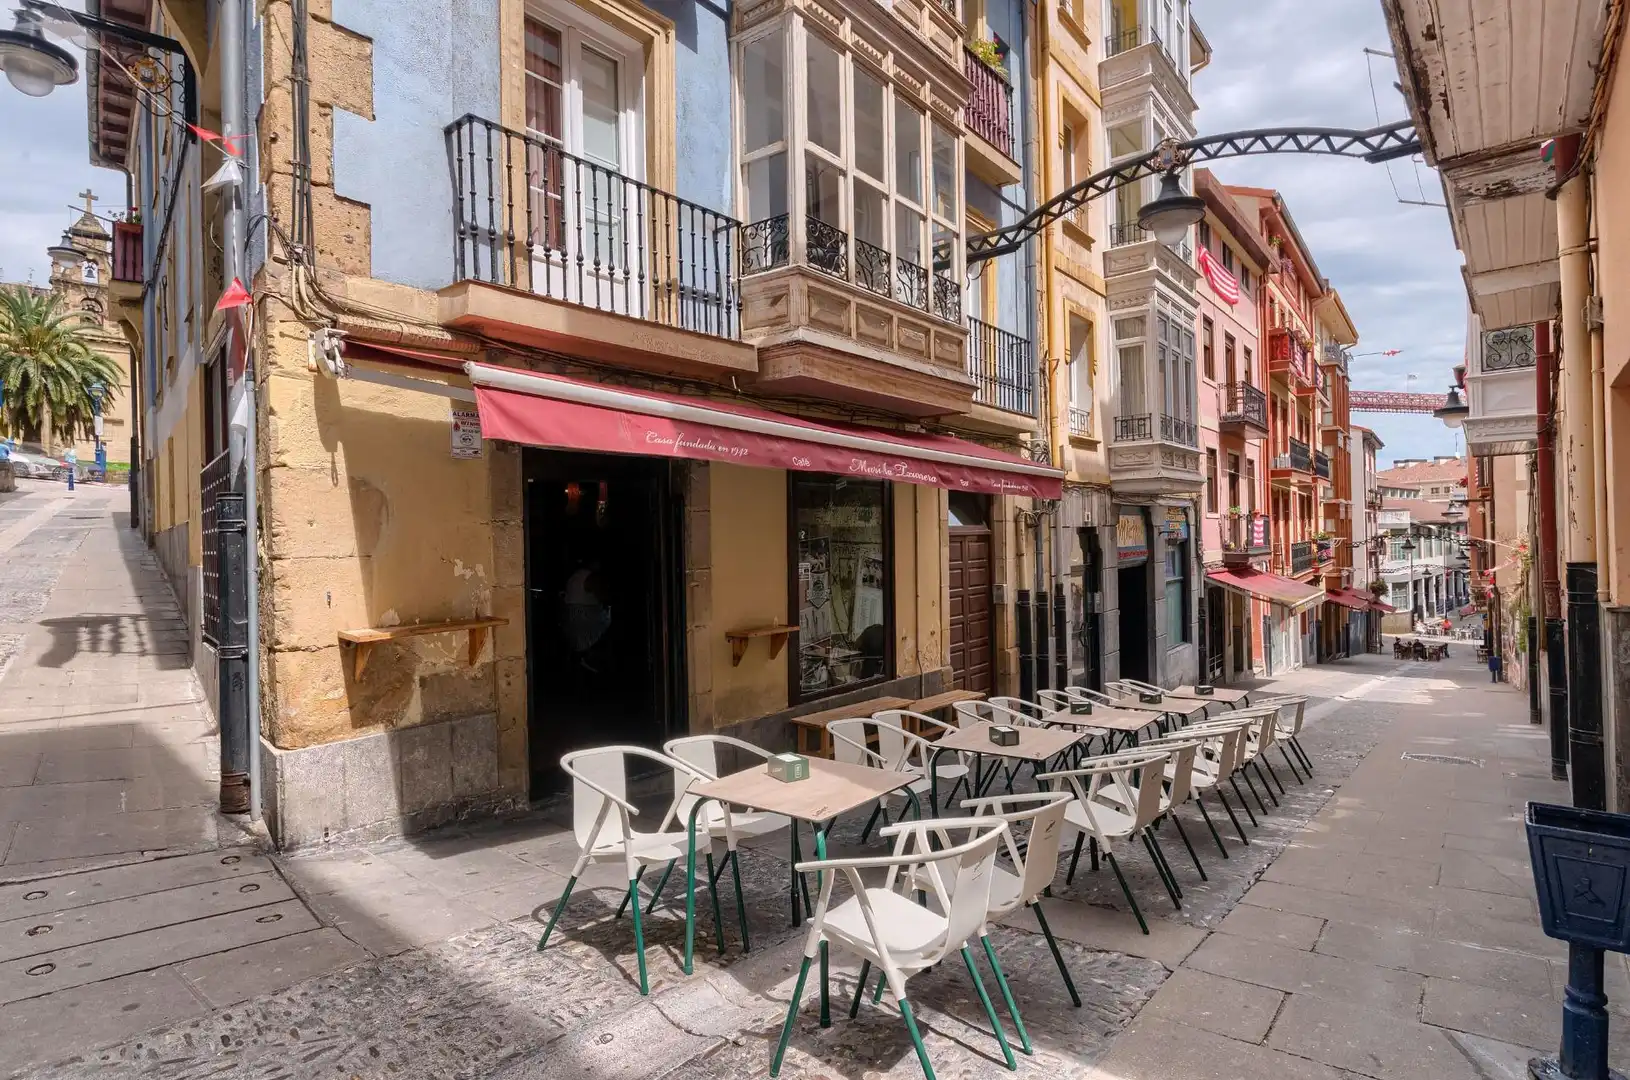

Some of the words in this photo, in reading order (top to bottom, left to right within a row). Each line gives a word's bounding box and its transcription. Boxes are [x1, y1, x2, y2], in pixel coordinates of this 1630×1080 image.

[645, 430, 674, 445] Casa
[673, 432, 717, 453] fundada
[792, 456, 811, 467] Café
[849, 458, 881, 474] Mari
